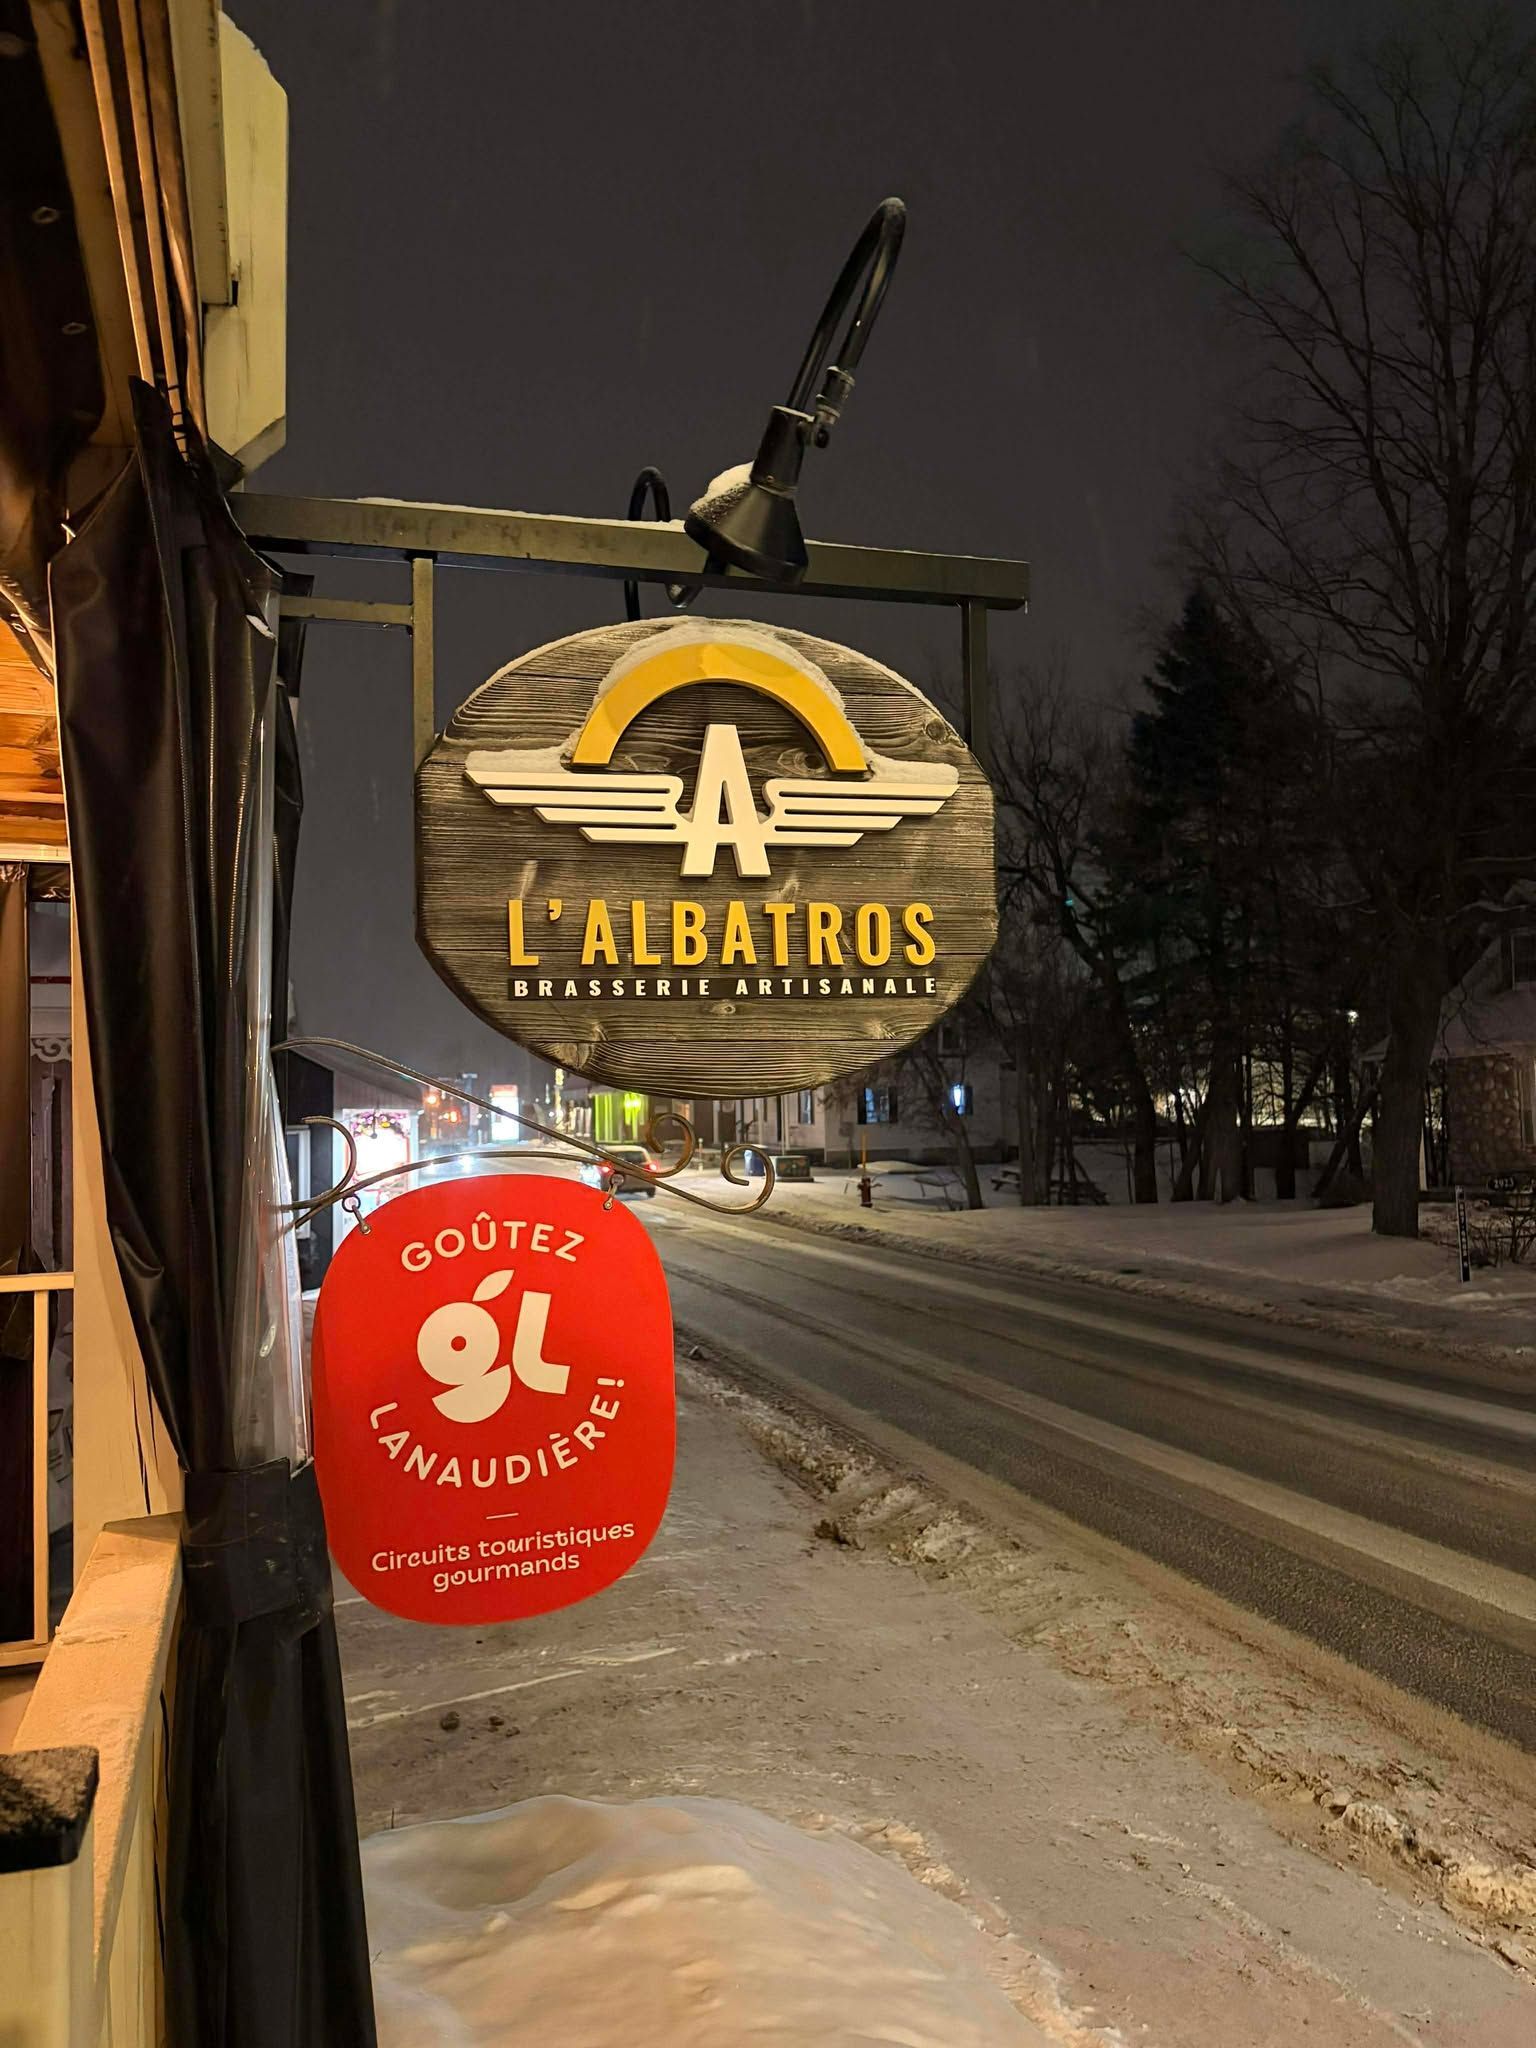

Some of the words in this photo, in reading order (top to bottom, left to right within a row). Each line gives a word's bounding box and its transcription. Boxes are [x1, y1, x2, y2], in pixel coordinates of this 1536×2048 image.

[680, 724, 772, 877] A
[514, 979, 711, 997] BRASSERIE
[735, 977, 937, 995] ARTISANALE
[401, 1211, 585, 1272] GOÛTEZ
[370, 1376, 625, 1488] LANAUDIÈRE!
[371, 1544, 471, 1572] Circuits
[478, 1522, 635, 1558] touristiques
[433, 1551, 580, 1593] gourmands
